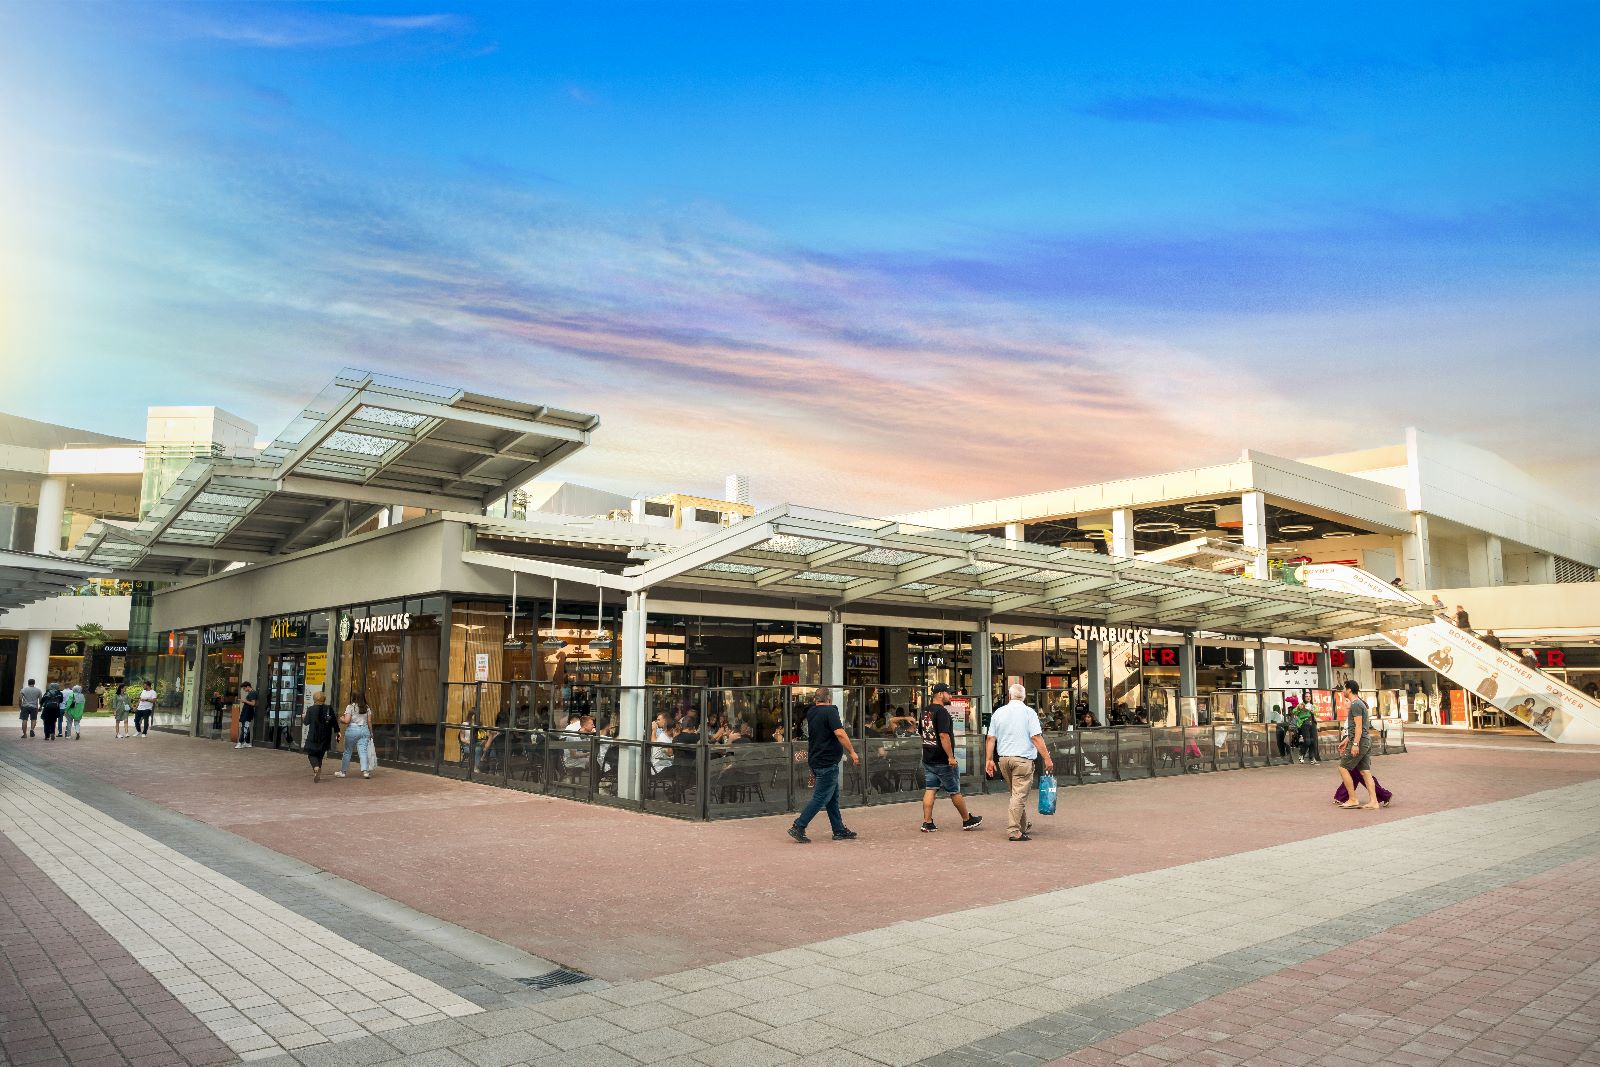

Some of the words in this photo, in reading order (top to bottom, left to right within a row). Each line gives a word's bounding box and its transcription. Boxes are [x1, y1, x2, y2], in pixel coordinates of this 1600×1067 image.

[353, 613, 410, 634] STARBUCKS
[1073, 624, 1149, 645] STARBUCKS
[1449, 629, 1484, 652] BOYNER
[1496, 656, 1533, 680] BOYNER
[1545, 685, 1585, 711] BOYNER
